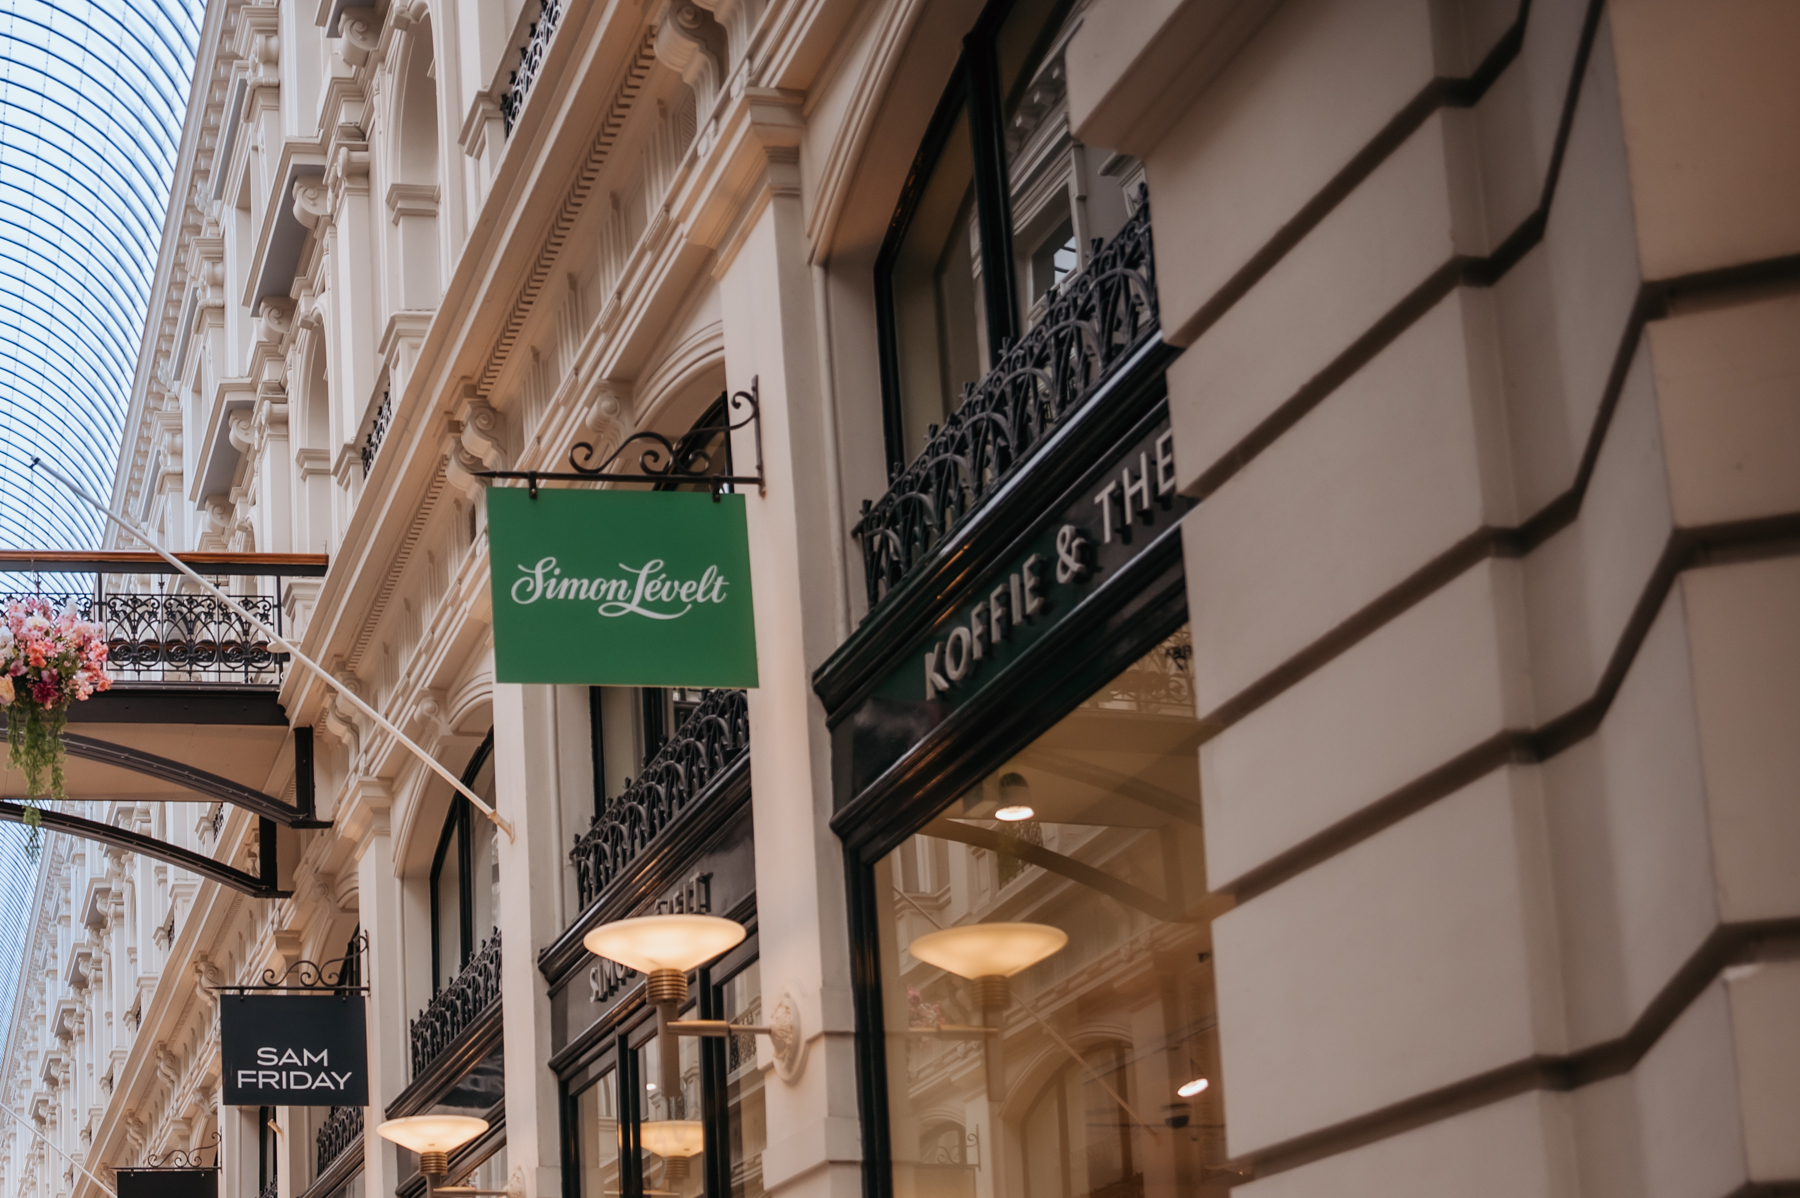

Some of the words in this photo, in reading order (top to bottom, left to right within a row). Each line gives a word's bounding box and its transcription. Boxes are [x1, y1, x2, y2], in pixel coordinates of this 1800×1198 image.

[511, 556, 631, 605] Simon
[598, 559, 730, 620] Lévelt
[925, 554, 1043, 700] KOFFIE
[1056, 525, 1086, 583] &
[256, 1047, 328, 1066] SAM
[237, 1070, 352, 1090] FRIDAY
